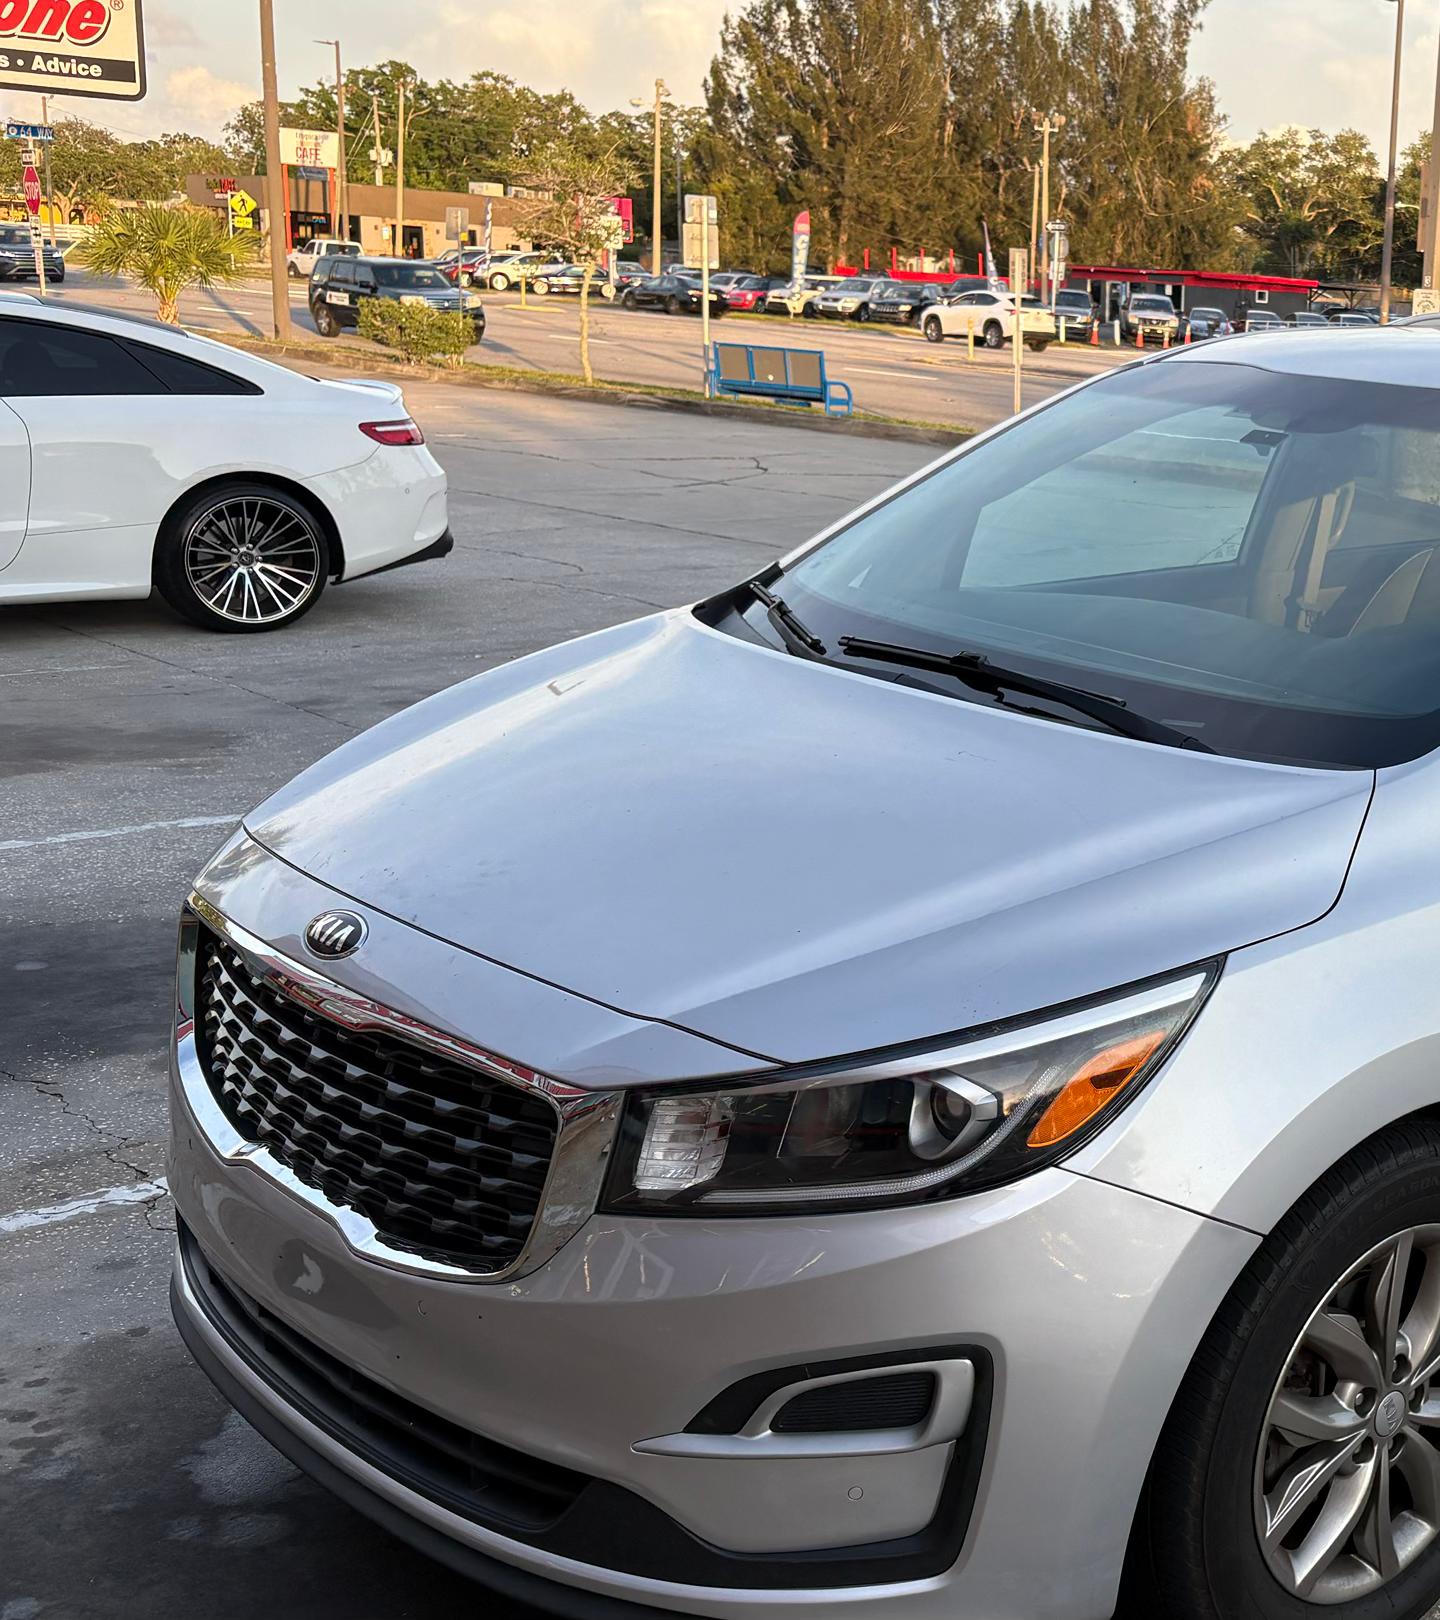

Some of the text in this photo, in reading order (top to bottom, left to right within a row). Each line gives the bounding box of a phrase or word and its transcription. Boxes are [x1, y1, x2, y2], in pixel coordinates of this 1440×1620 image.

[31, 55, 103, 77] Advice
[37, 127, 54, 139] WAY
[295, 146, 321, 160] CAFE
[25, 181, 40, 200] STOP
[308, 914, 355, 952] KIA
